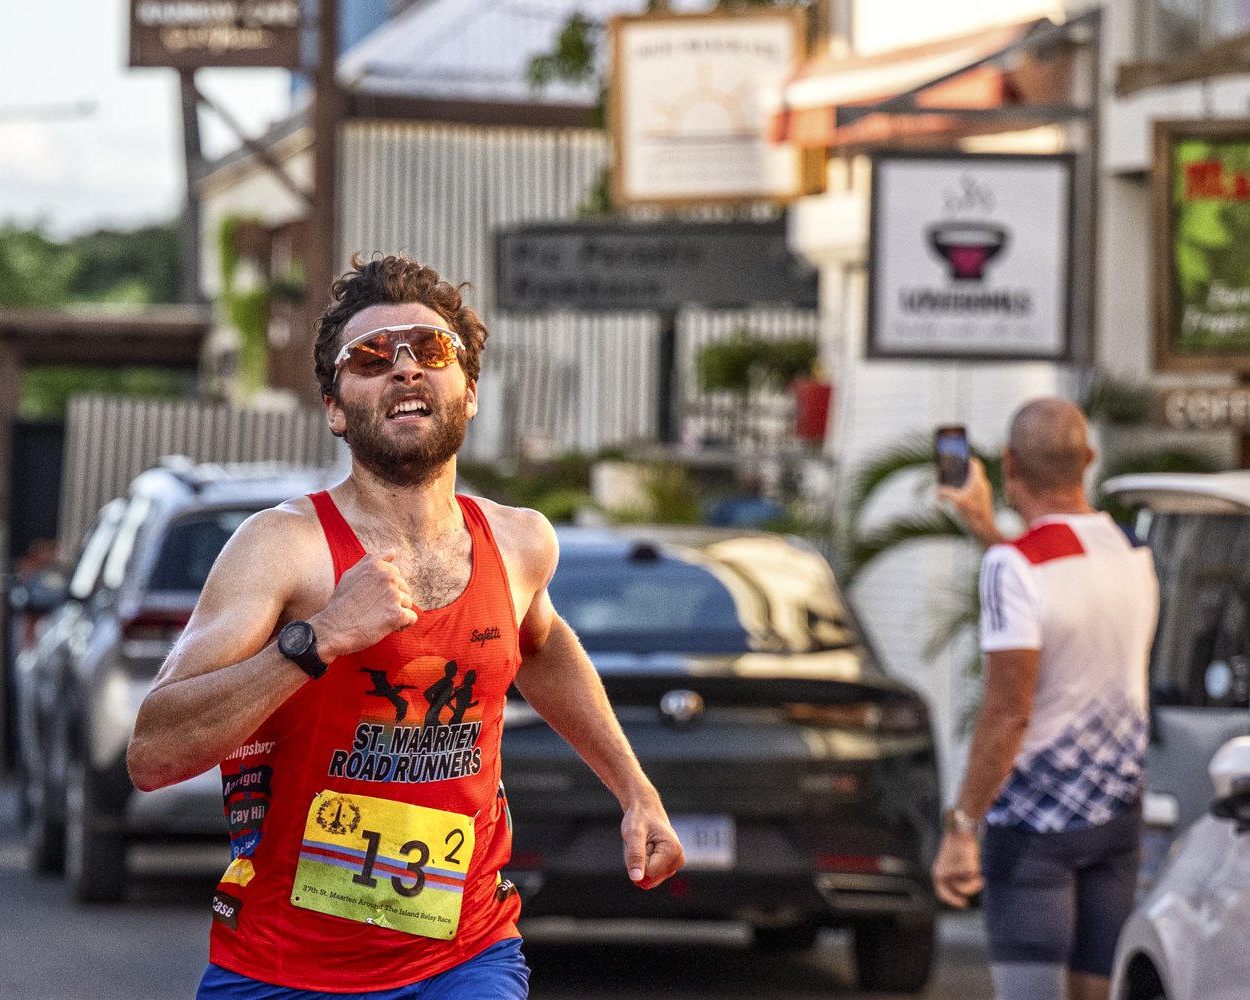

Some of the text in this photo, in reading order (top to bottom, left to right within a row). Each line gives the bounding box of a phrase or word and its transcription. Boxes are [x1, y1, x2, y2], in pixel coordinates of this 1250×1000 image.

[353, 721, 483, 755] ST. MAARTEN
[328, 747, 481, 784] ROAD RUNNERS
[231, 808, 249, 825] Cay
[302, 884, 452, 924] 37th St. Maarten Around The Island Relay Race
